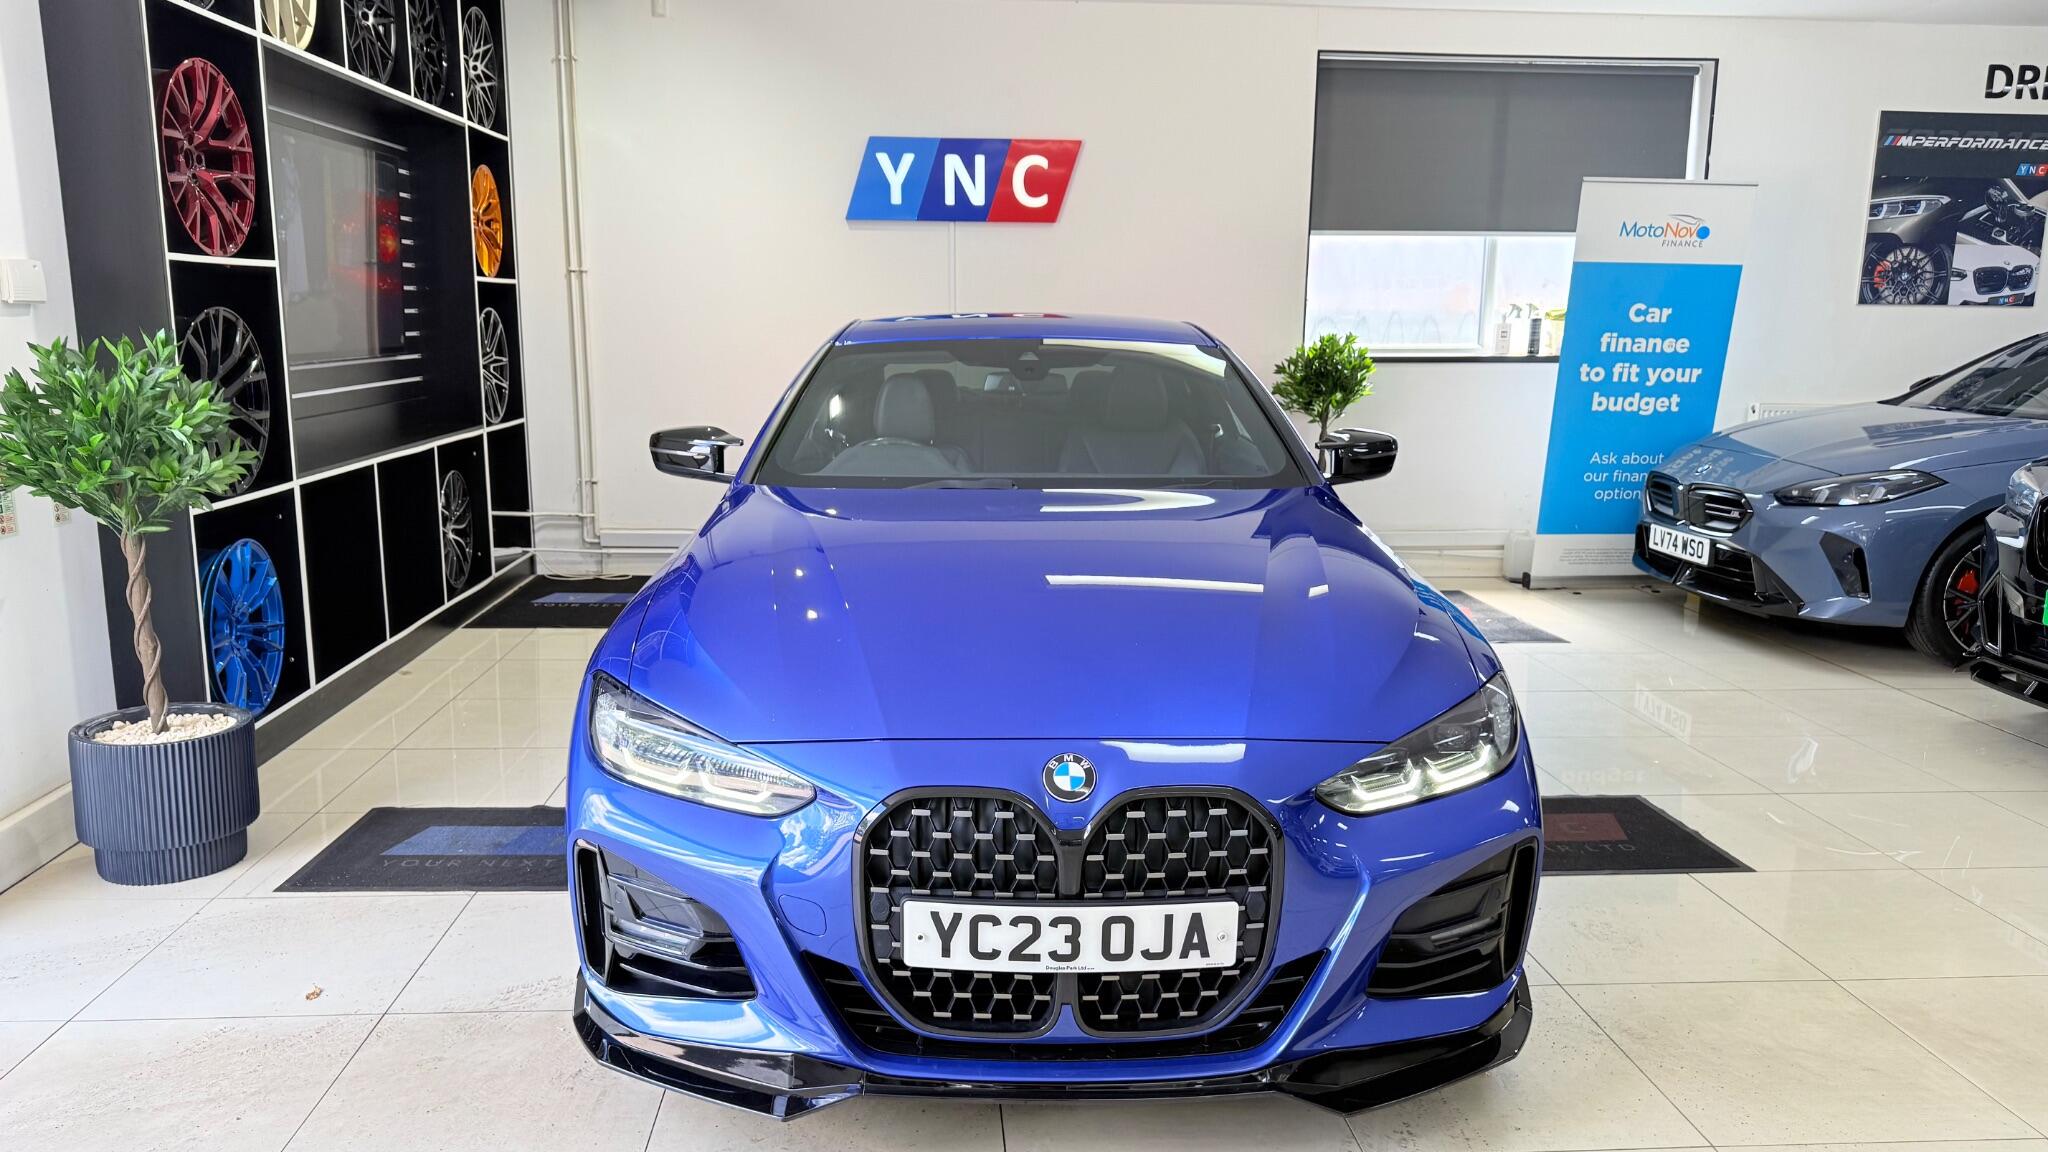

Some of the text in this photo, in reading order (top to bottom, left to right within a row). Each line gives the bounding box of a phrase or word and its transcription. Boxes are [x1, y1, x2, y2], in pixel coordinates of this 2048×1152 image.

[2020, 165, 2046, 175] YNC
[875, 152, 1049, 208] YNC
[1661, 239, 1704, 248] FINANCE
[1628, 302, 1673, 323] Car
[1600, 332, 1690, 354] finance
[1580, 362, 1702, 387] to fit your
[1591, 391, 1680, 416] budget
[1590, 451, 1664, 465] Ask about
[1583, 469, 1648, 482] our finan
[1594, 487, 1641, 502] option
[1653, 525, 1704, 560] LV74 WSO
[1048, 753, 1092, 770] BMW
[382, 858, 558, 868] YOUR NEXT
[930, 910, 1211, 963] YC23 OJA
